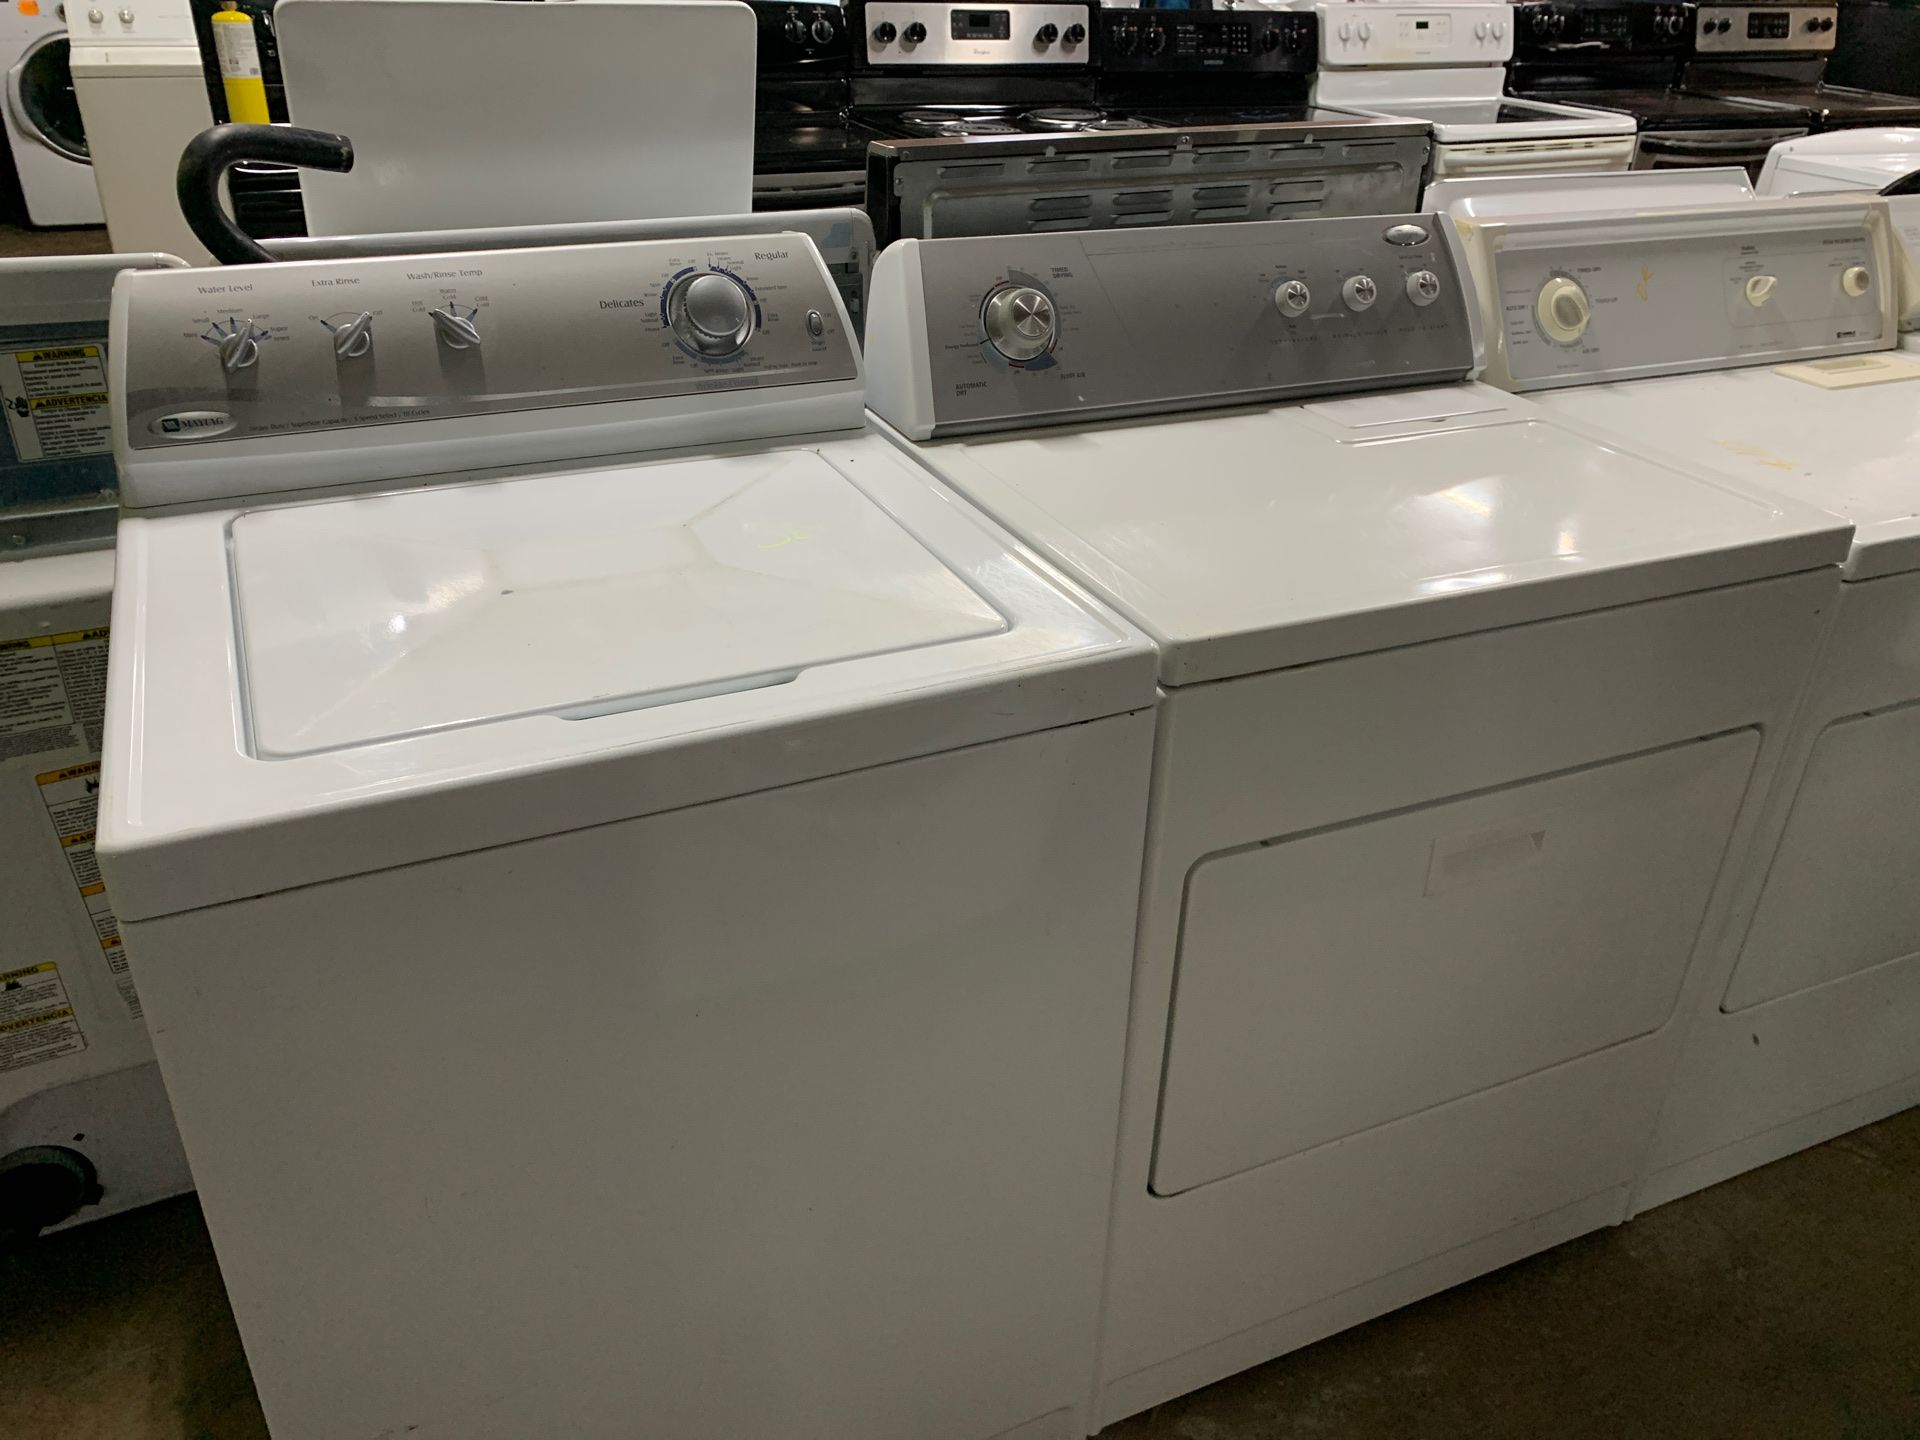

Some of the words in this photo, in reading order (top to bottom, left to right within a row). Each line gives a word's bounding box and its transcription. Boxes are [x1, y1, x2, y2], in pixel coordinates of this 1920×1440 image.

[754, 250, 789, 261] Regular
[407, 271, 457, 281] Wash/Rinse
[459, 269, 483, 279] Temp
[312, 278, 334, 287] Extra
[335, 276, 361, 286] Rinse
[197, 285, 226, 295] Water
[228, 282, 254, 293] Level
[599, 298, 646, 310] Delicates
[43, 349, 86, 359] WARNING
[955, 380, 988, 391] AUTOMATIC
[45, 394, 108, 407] ADVERTENCIA
[181, 417, 225, 429] MAYTAG
